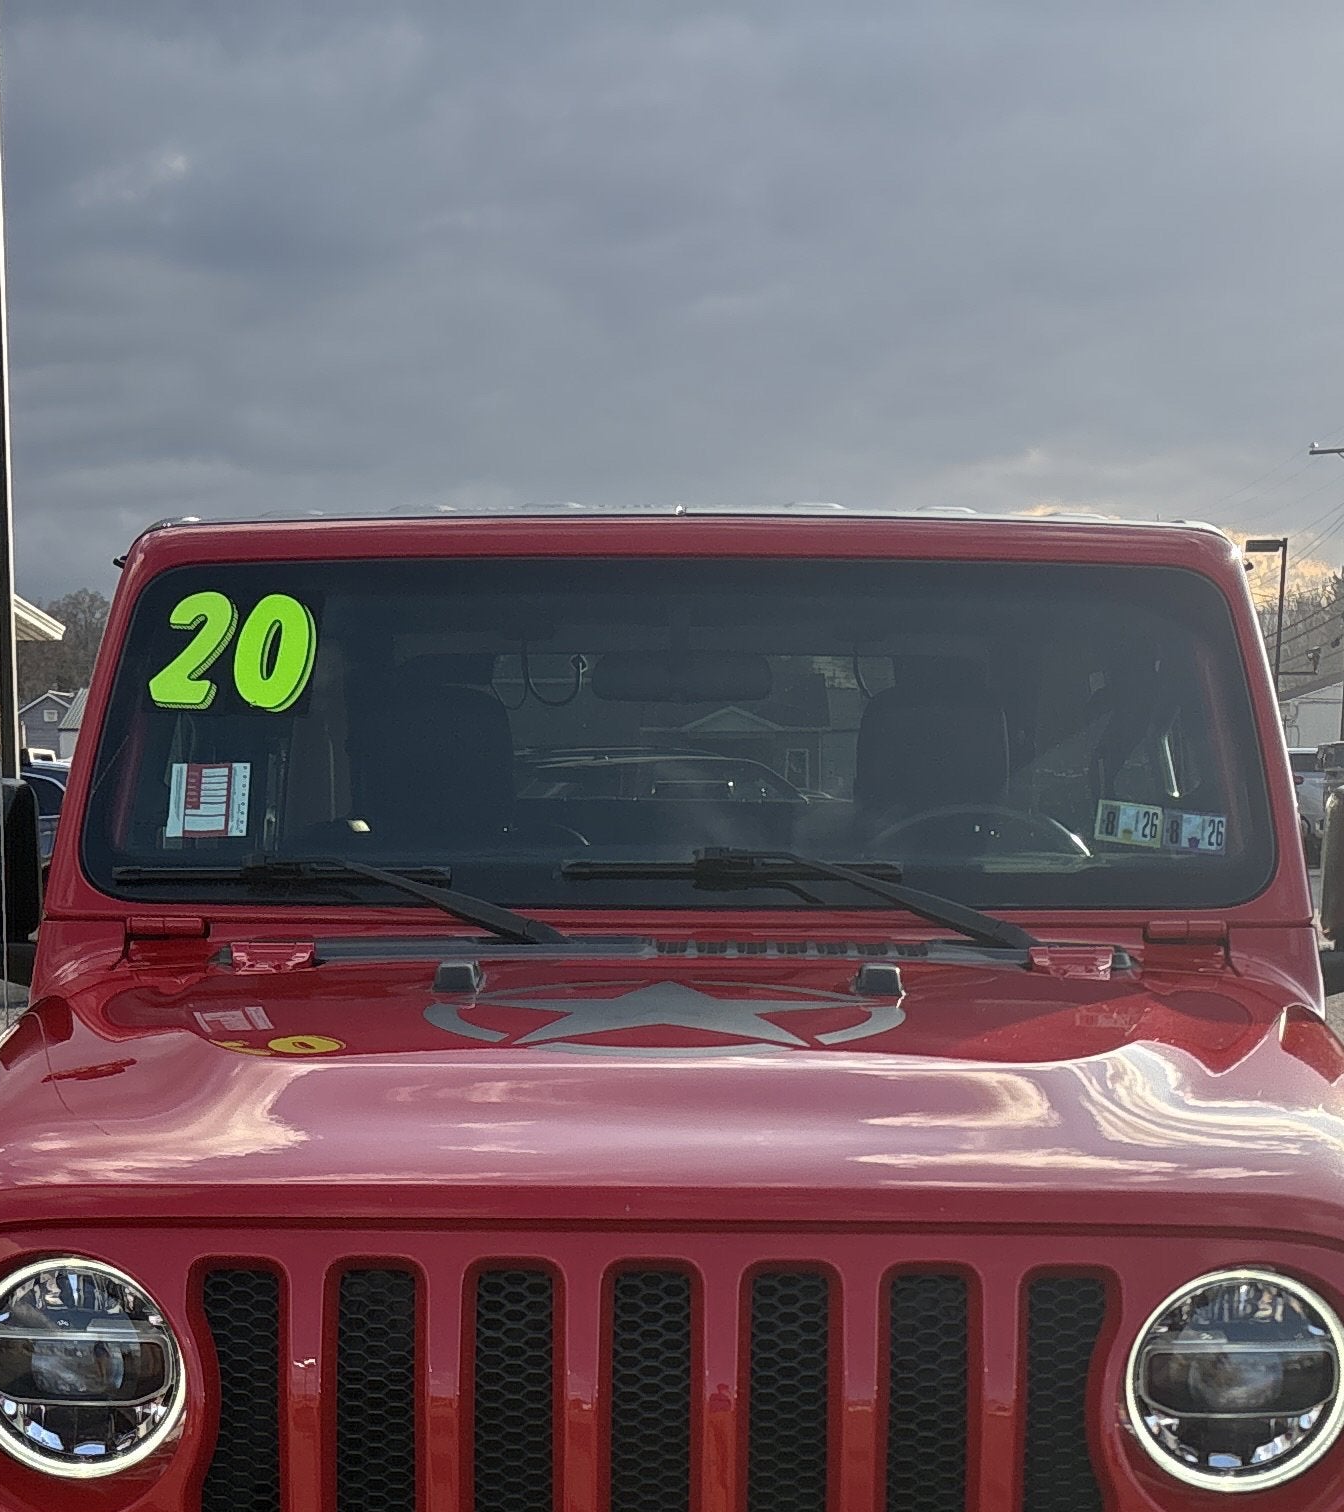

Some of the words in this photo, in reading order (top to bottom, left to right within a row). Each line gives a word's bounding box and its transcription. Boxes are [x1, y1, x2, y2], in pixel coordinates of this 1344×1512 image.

[149, 591, 317, 712] 20
[1105, 811, 1116, 836] 8
[1141, 811, 1159, 839] 26
[1169, 820, 1180, 845] 8
[1207, 819, 1224, 847] 26
